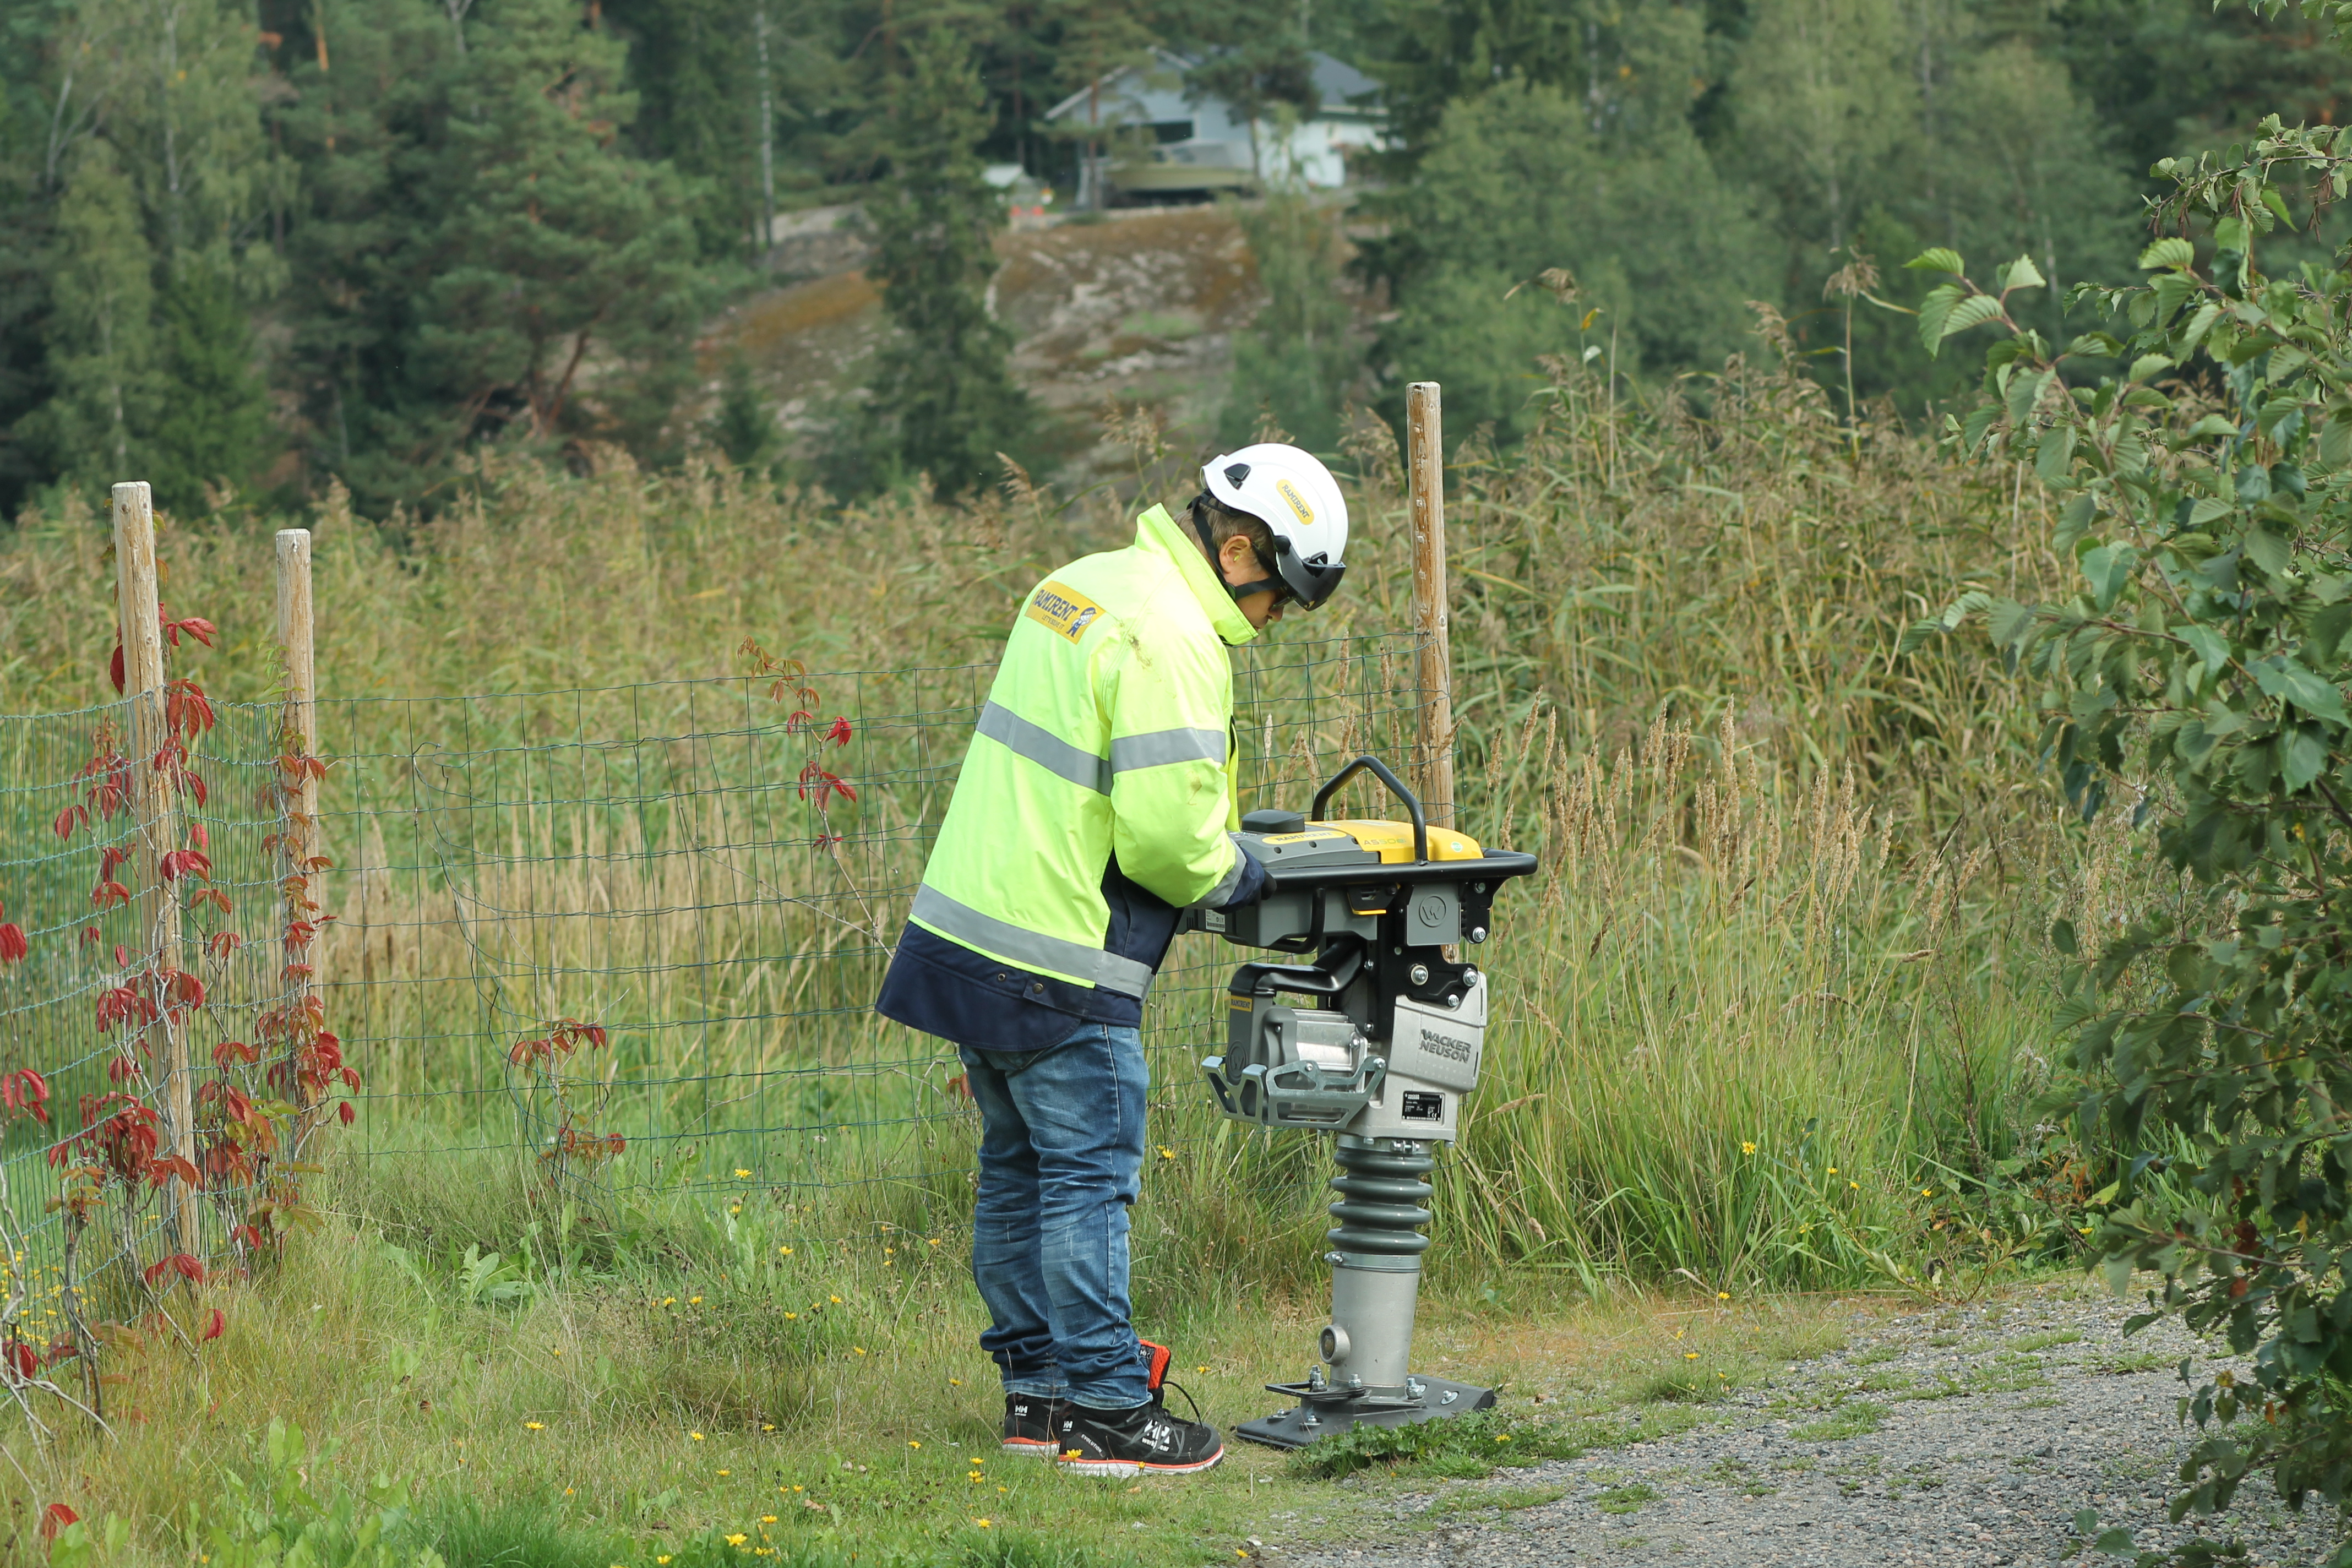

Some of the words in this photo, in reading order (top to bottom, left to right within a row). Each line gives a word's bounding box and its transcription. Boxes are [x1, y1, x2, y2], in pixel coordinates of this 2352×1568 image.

[1282, 484, 1310, 519] RAMIRENT
[1033, 589, 1079, 621] RAMIRENT
[1276, 832, 1332, 841] RAMIRENT
[1231, 999, 1250, 1008] RAMIRENT
[1419, 1039, 1470, 1063] NEUSON
[1420, 1028, 1471, 1053] WACKER
[1081, 1434, 1102, 1453] EVOLUTION
[1142, 1437, 1169, 1452] workear
